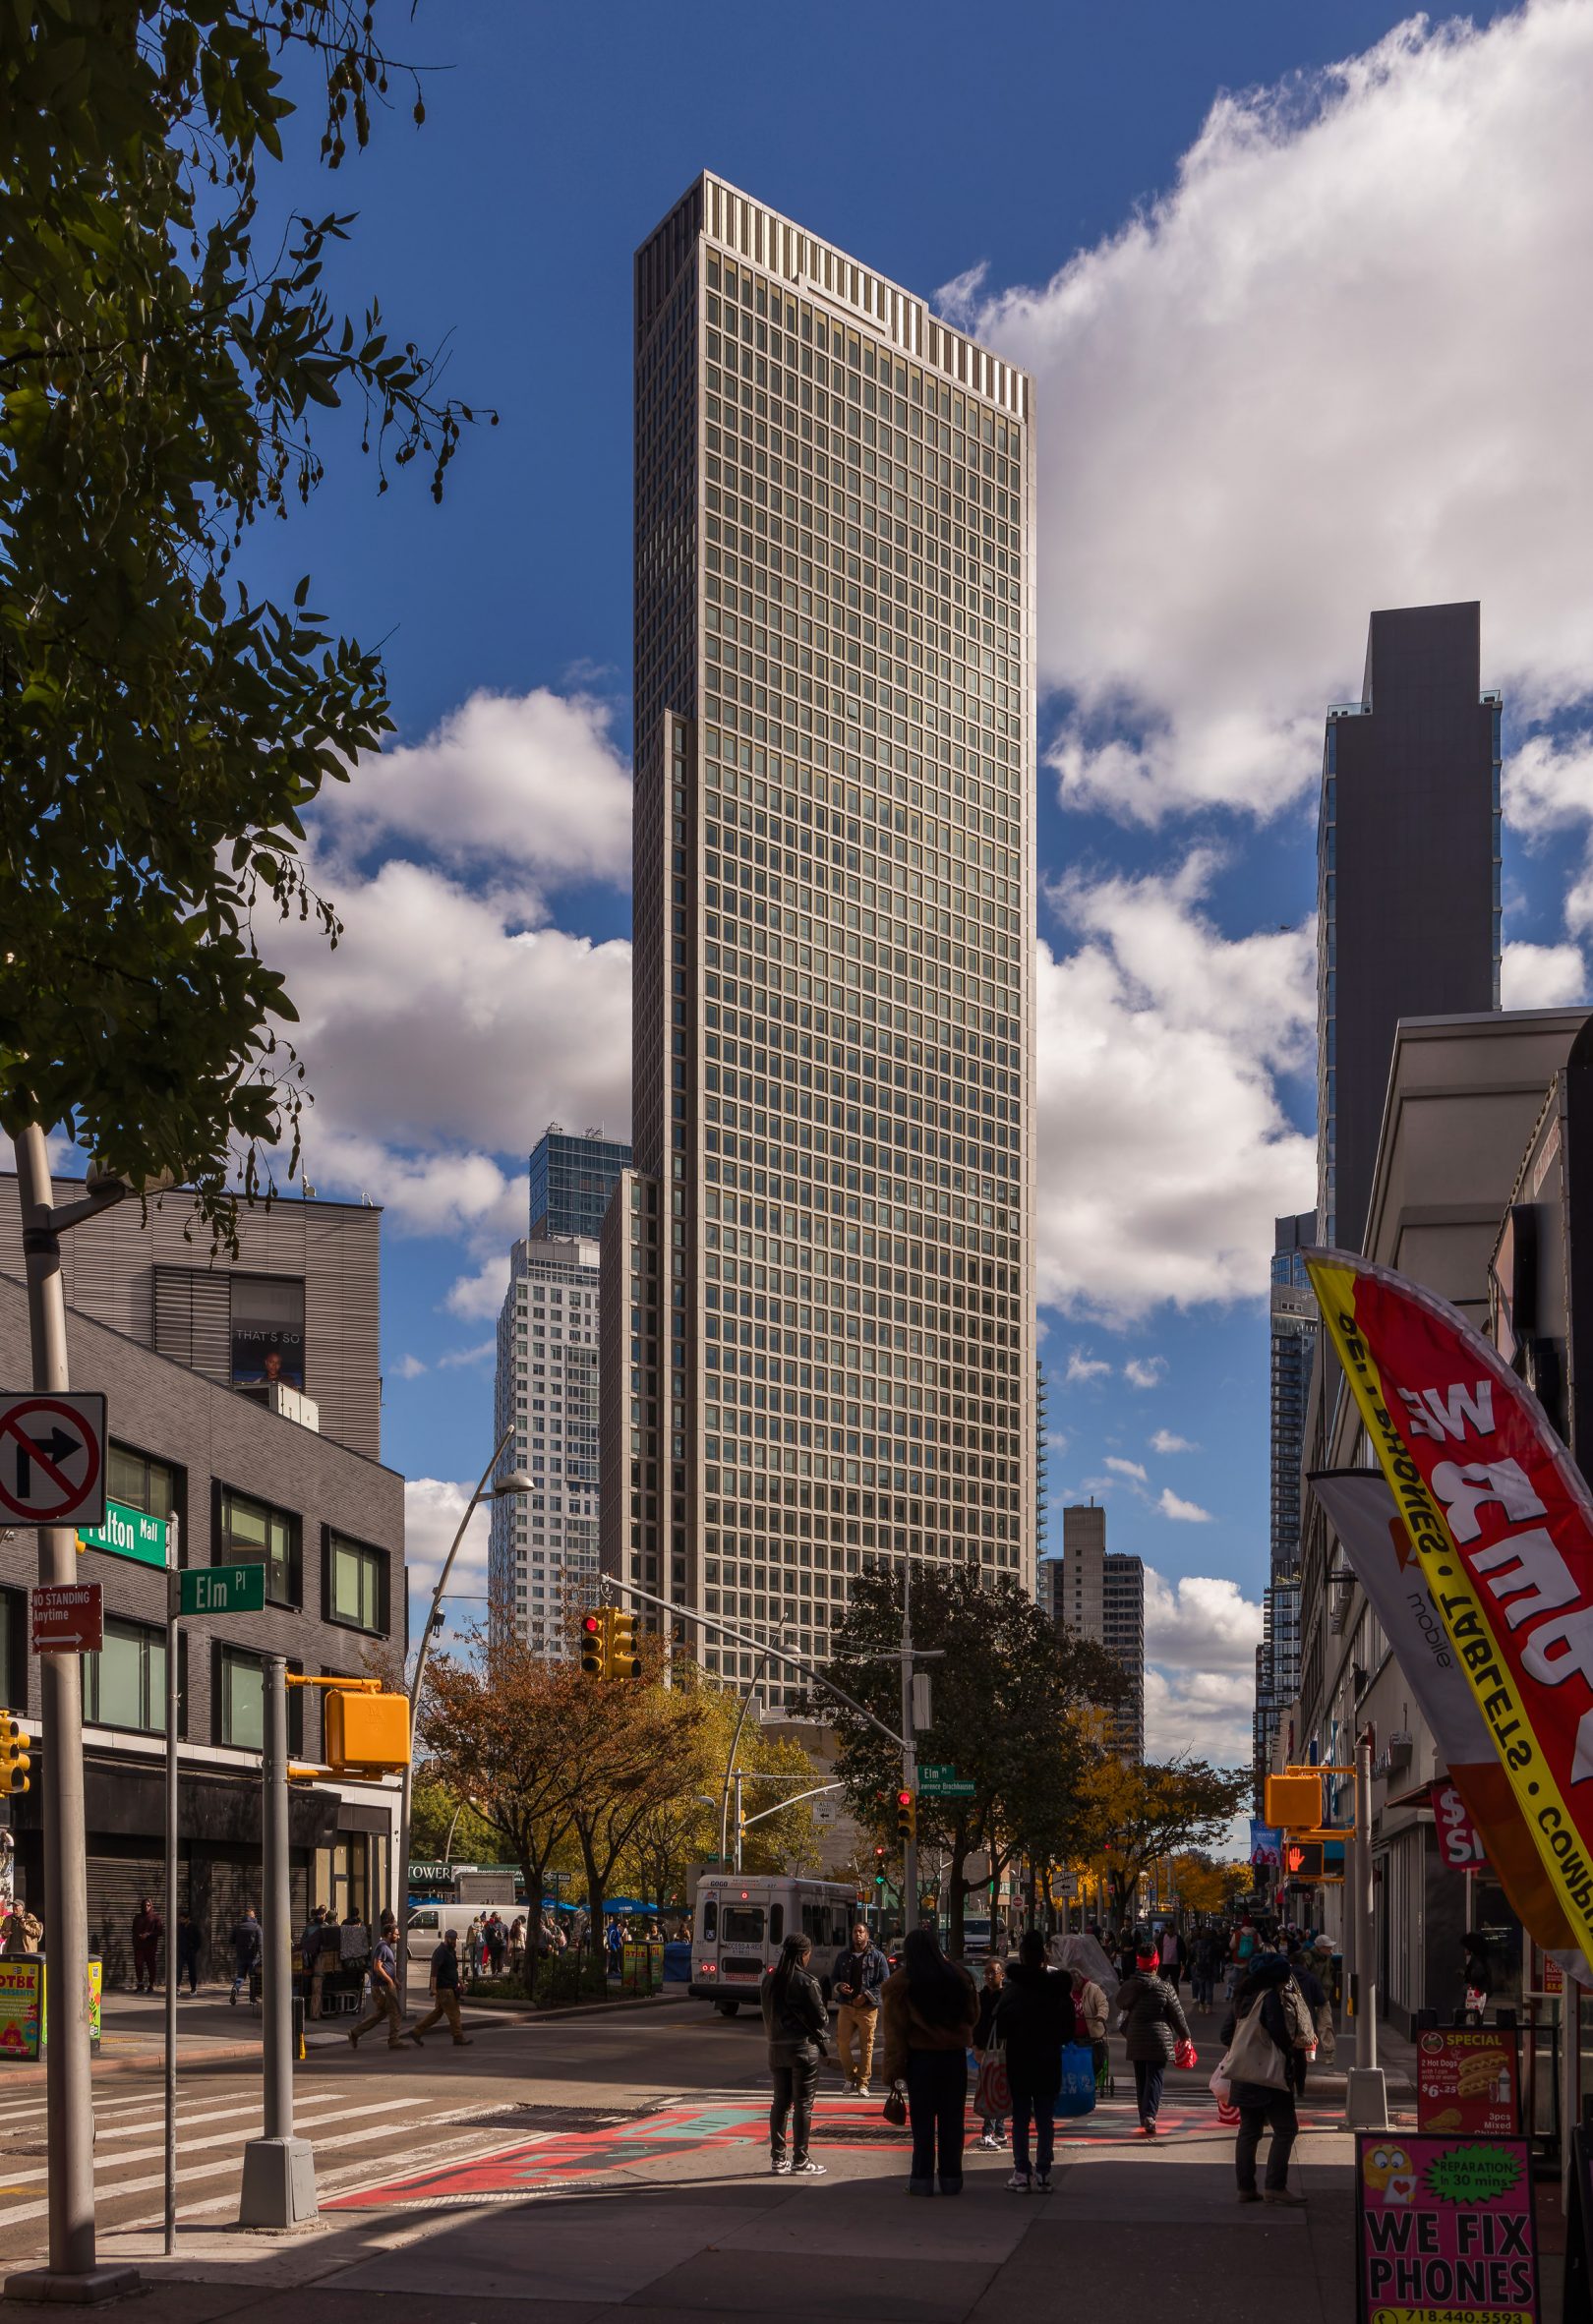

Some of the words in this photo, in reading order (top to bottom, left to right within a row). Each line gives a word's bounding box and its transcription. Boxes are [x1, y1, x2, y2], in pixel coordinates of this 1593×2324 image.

[236, 1329, 278, 1343] THAT'S
[282, 1333, 300, 1344] SO
[140, 1518, 158, 1542] Mall
[196, 1576, 228, 1609] Elm
[235, 1571, 246, 1591] Pl
[32, 1595, 44, 1607] NO
[45, 1591, 90, 1606] STANDING
[33, 1608, 69, 1624] Anytime
[1407, 1593, 1450, 1668] mobile
[924, 1768, 939, 1779] Elm
[408, 1866, 451, 1880] TOWER
[1446, 2034, 1503, 2046] SPECIAL
[1440, 2059, 1458, 2068] Dogs
[1489, 2113, 1511, 2121] 3pcs
[1440, 2162, 1512, 2174] REPARATION
[1453, 2175, 1471, 2186] 30
[1475, 2176, 1508, 2187] mins
[1364, 2210, 1441, 2254] WE
[1455, 2212, 1533, 2256] FIX
[1368, 2257, 1534, 2304] PHONES
[1406, 2309, 1523, 2324] 718.440.5593
